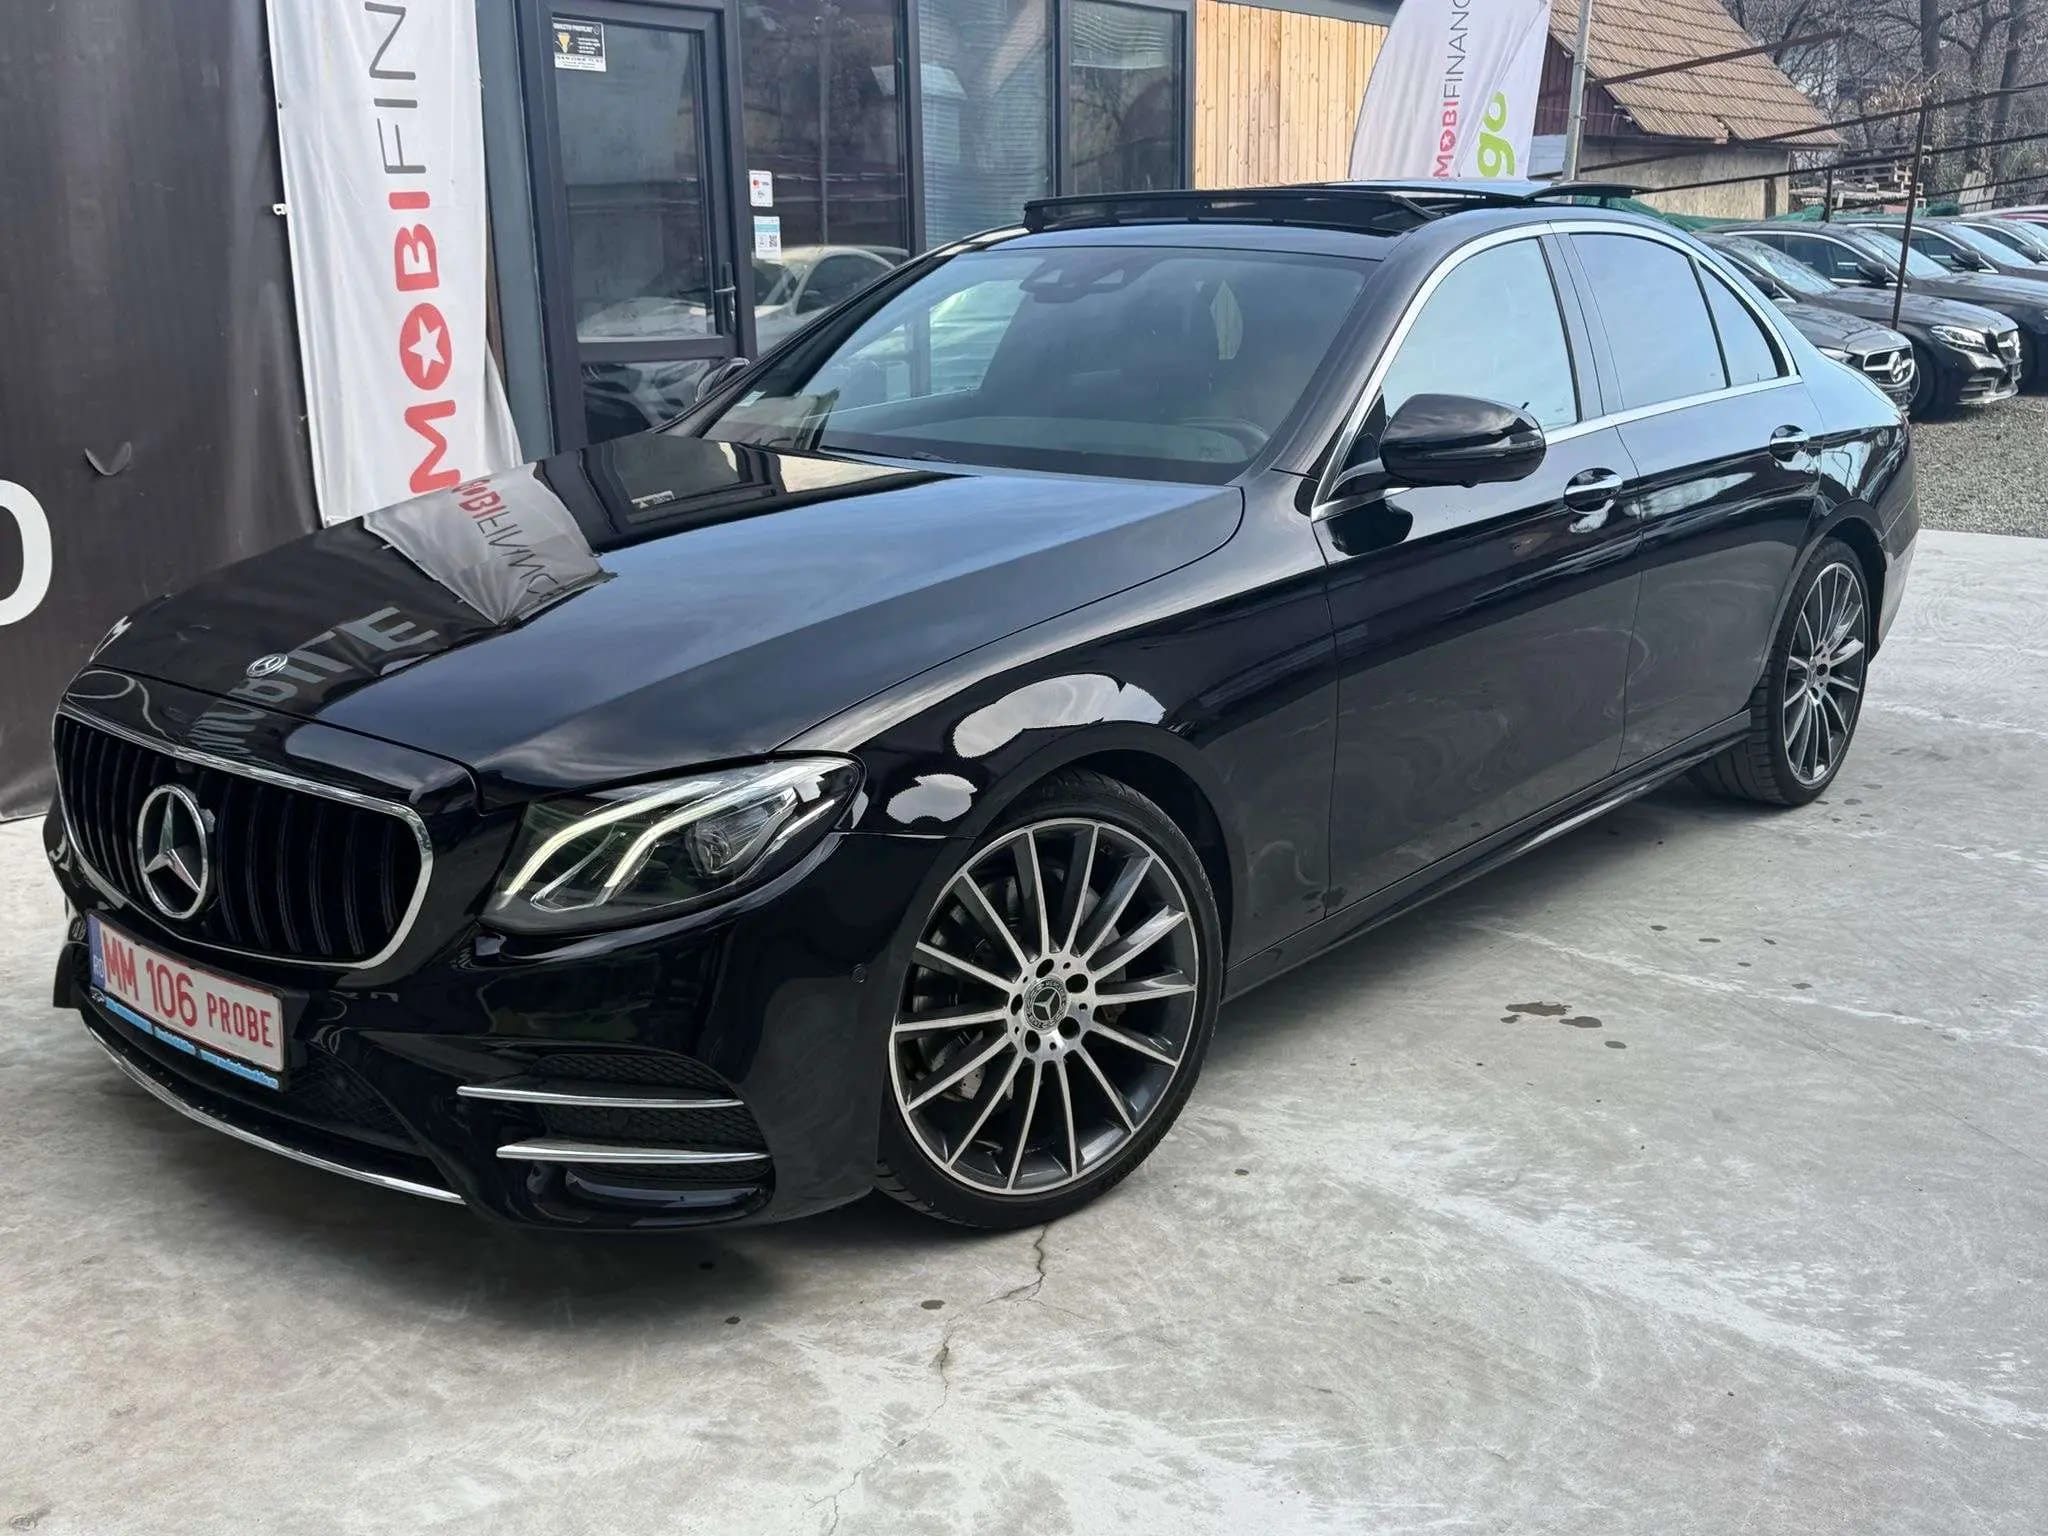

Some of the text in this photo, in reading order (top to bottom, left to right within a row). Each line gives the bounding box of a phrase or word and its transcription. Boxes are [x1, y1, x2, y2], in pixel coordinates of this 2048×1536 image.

[103, 930, 140, 1001] MM
[146, 958, 198, 1027] 106
[206, 991, 274, 1048] PROBE
